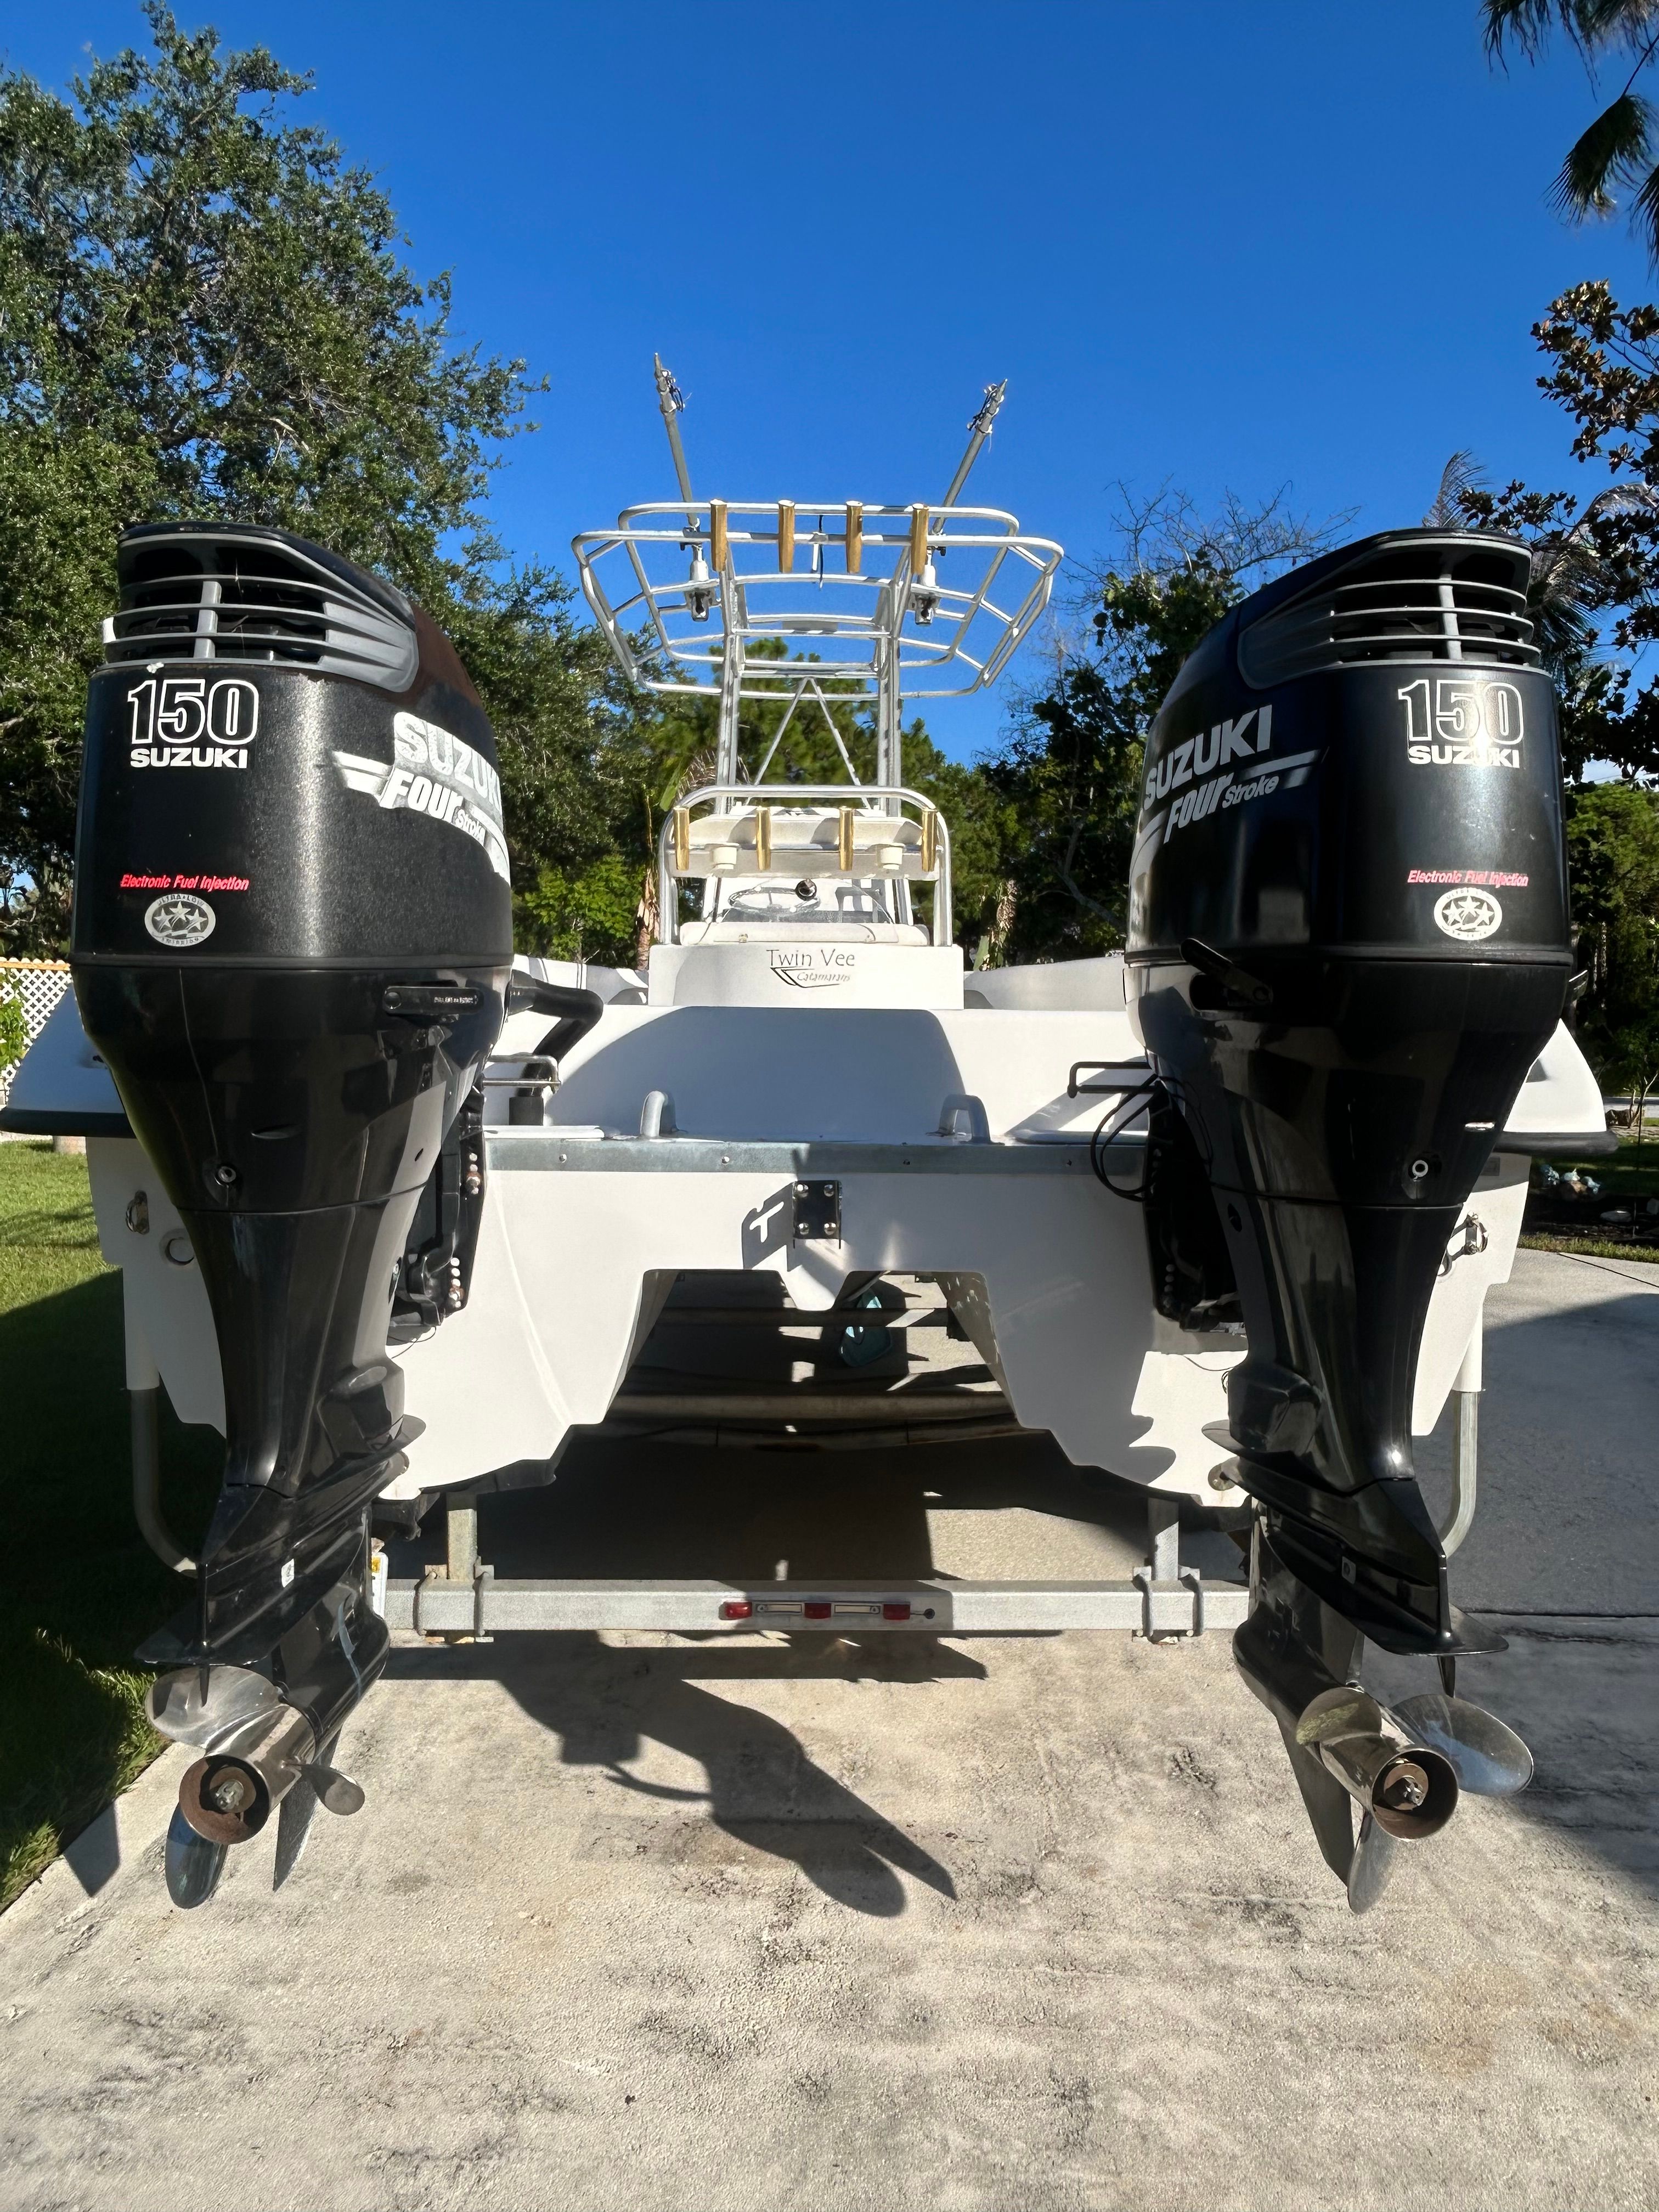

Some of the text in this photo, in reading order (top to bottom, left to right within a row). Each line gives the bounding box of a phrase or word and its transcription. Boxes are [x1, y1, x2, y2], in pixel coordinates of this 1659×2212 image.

[127, 679, 259, 745] 150
[1398, 680, 1523, 744] 150
[131, 747, 247, 768] SUZUKI
[1144, 704, 1272, 810] SUZUKI
[1408, 745, 1520, 768] SUZUKI
[1222, 775, 1279, 809] Stroke
[120, 874, 250, 892] Electronic Fuel Injection
[1407, 870, 1529, 888] Electronic Fuel Injection
[766, 949, 855, 966] Twin Vee
